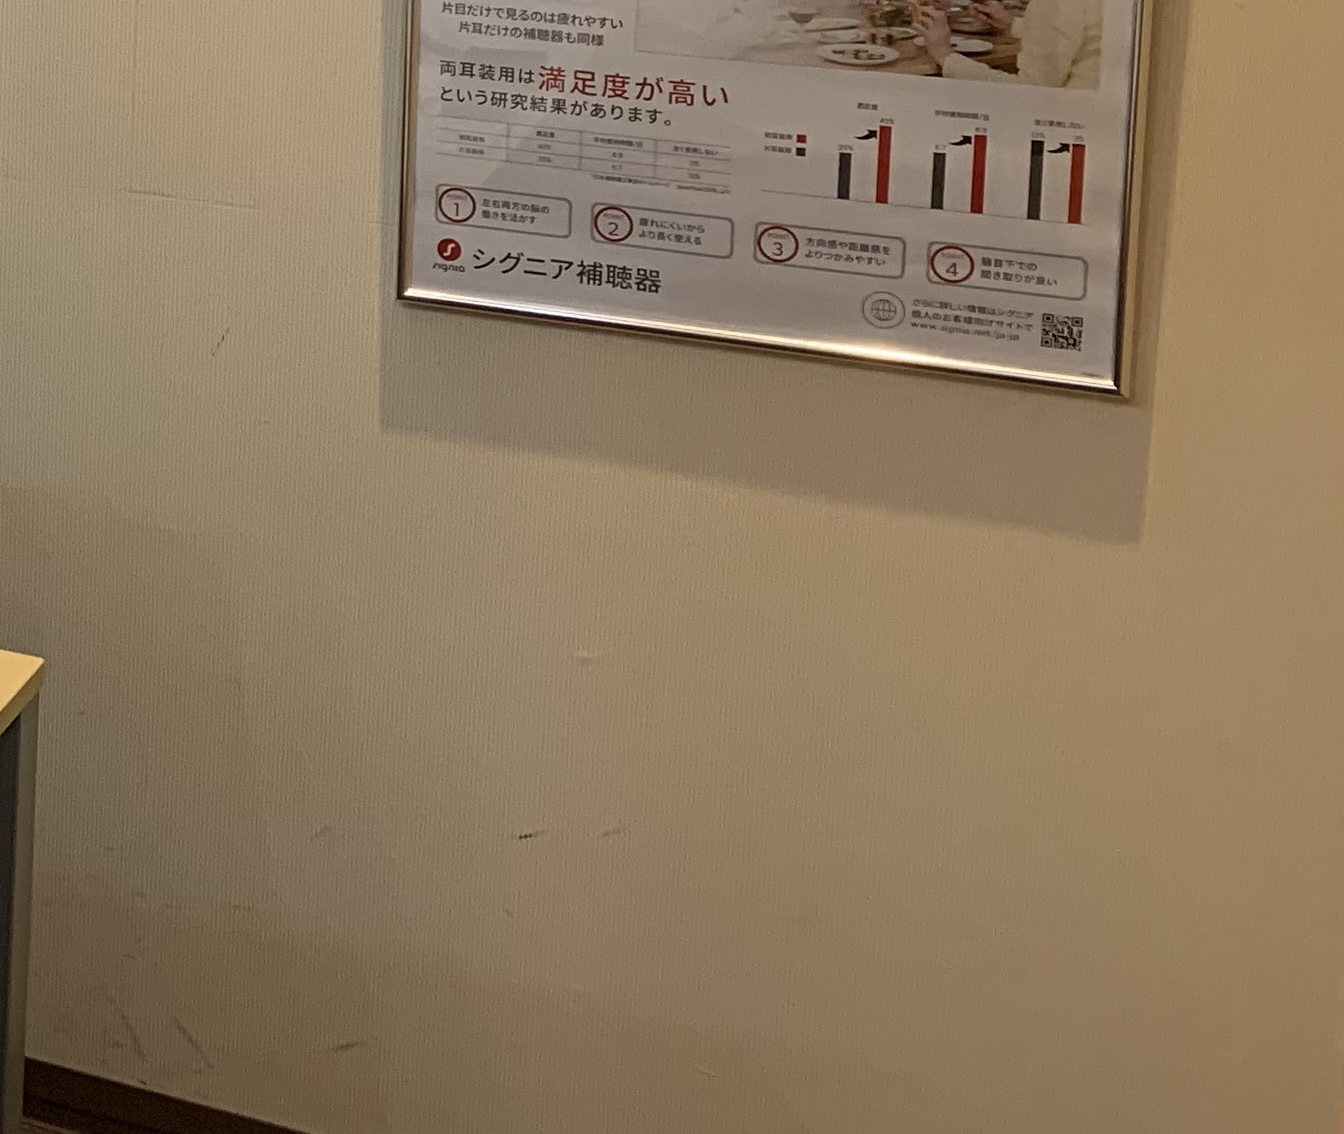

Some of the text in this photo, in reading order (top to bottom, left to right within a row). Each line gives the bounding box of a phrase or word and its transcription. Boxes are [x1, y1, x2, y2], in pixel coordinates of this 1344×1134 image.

[442, 1, 624, 30] 片目だけで見るのは疲れやすい
[439, 86, 672, 127] という研究結果があります。
[453, 203, 460, 216] 1
[608, 222, 620, 236] 2
[772, 242, 784, 256] 3
[472, 248, 661, 294] シグニア補聴器
[945, 262, 959, 277] 4
